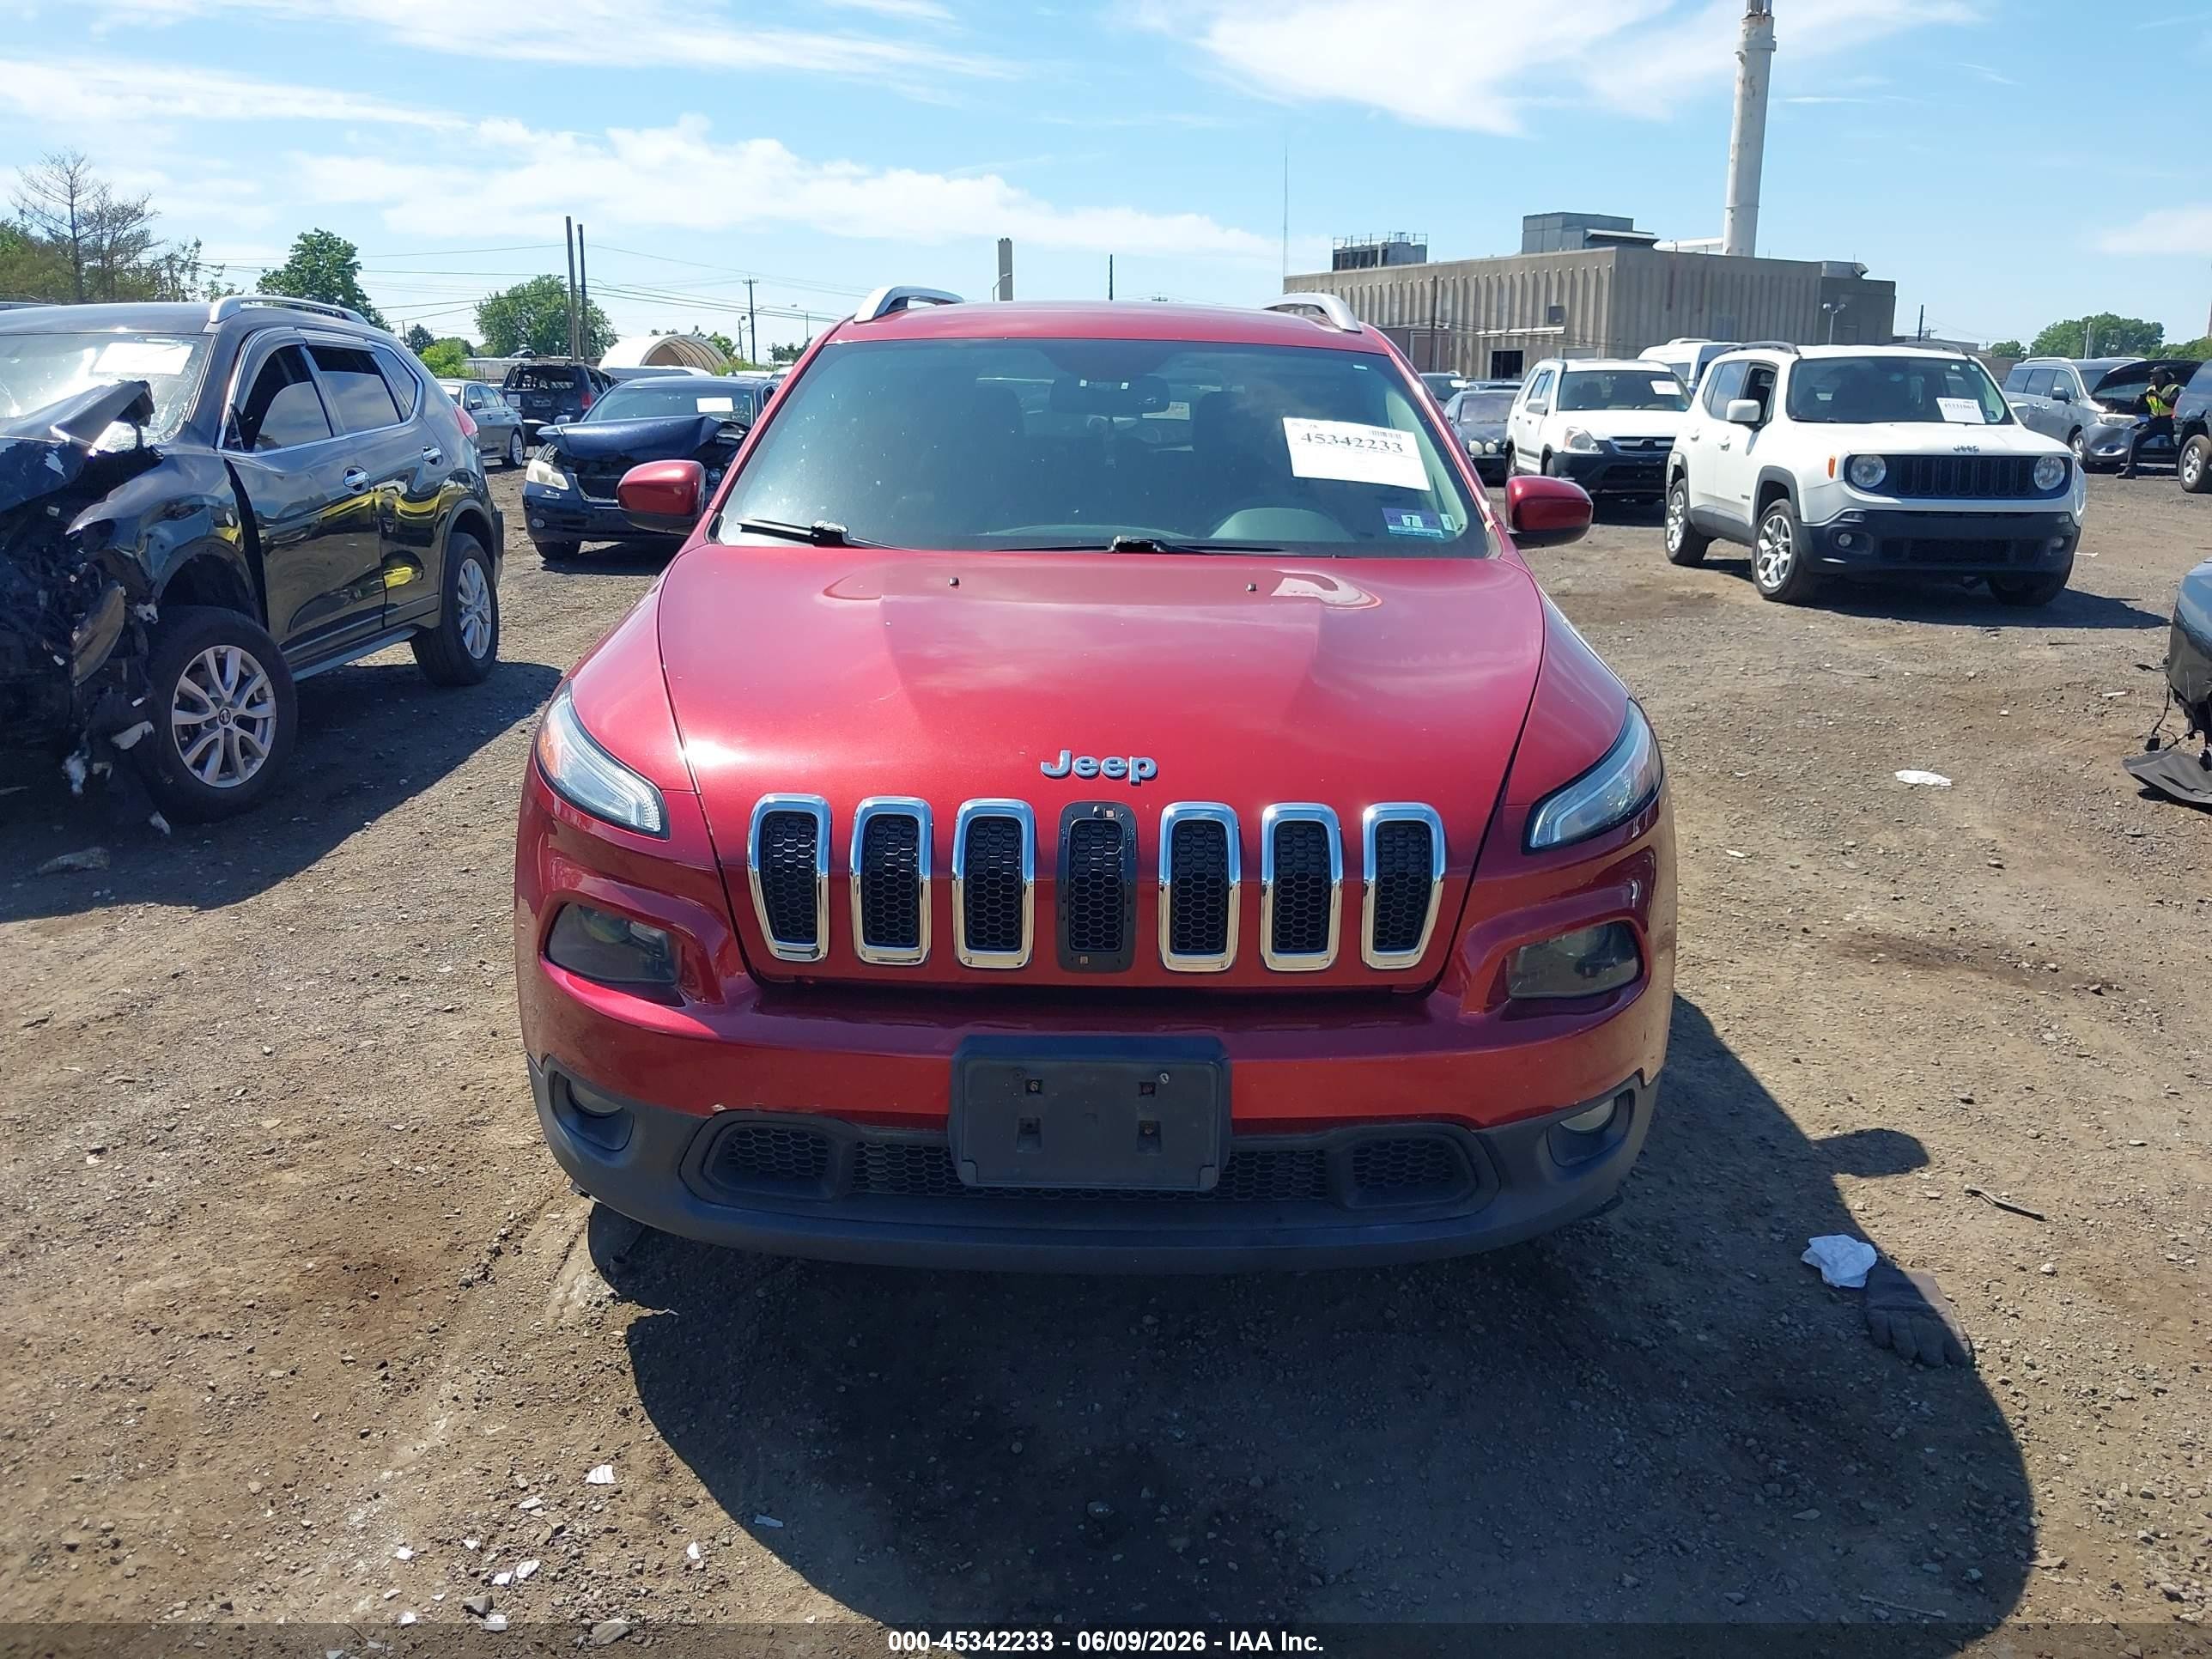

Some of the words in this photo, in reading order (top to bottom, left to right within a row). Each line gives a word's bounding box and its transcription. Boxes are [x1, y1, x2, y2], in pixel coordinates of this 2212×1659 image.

[1300, 432, 1404, 453] 45342233
[1407, 516, 1413, 526] 7
[1040, 749, 1158, 784] Jeep
